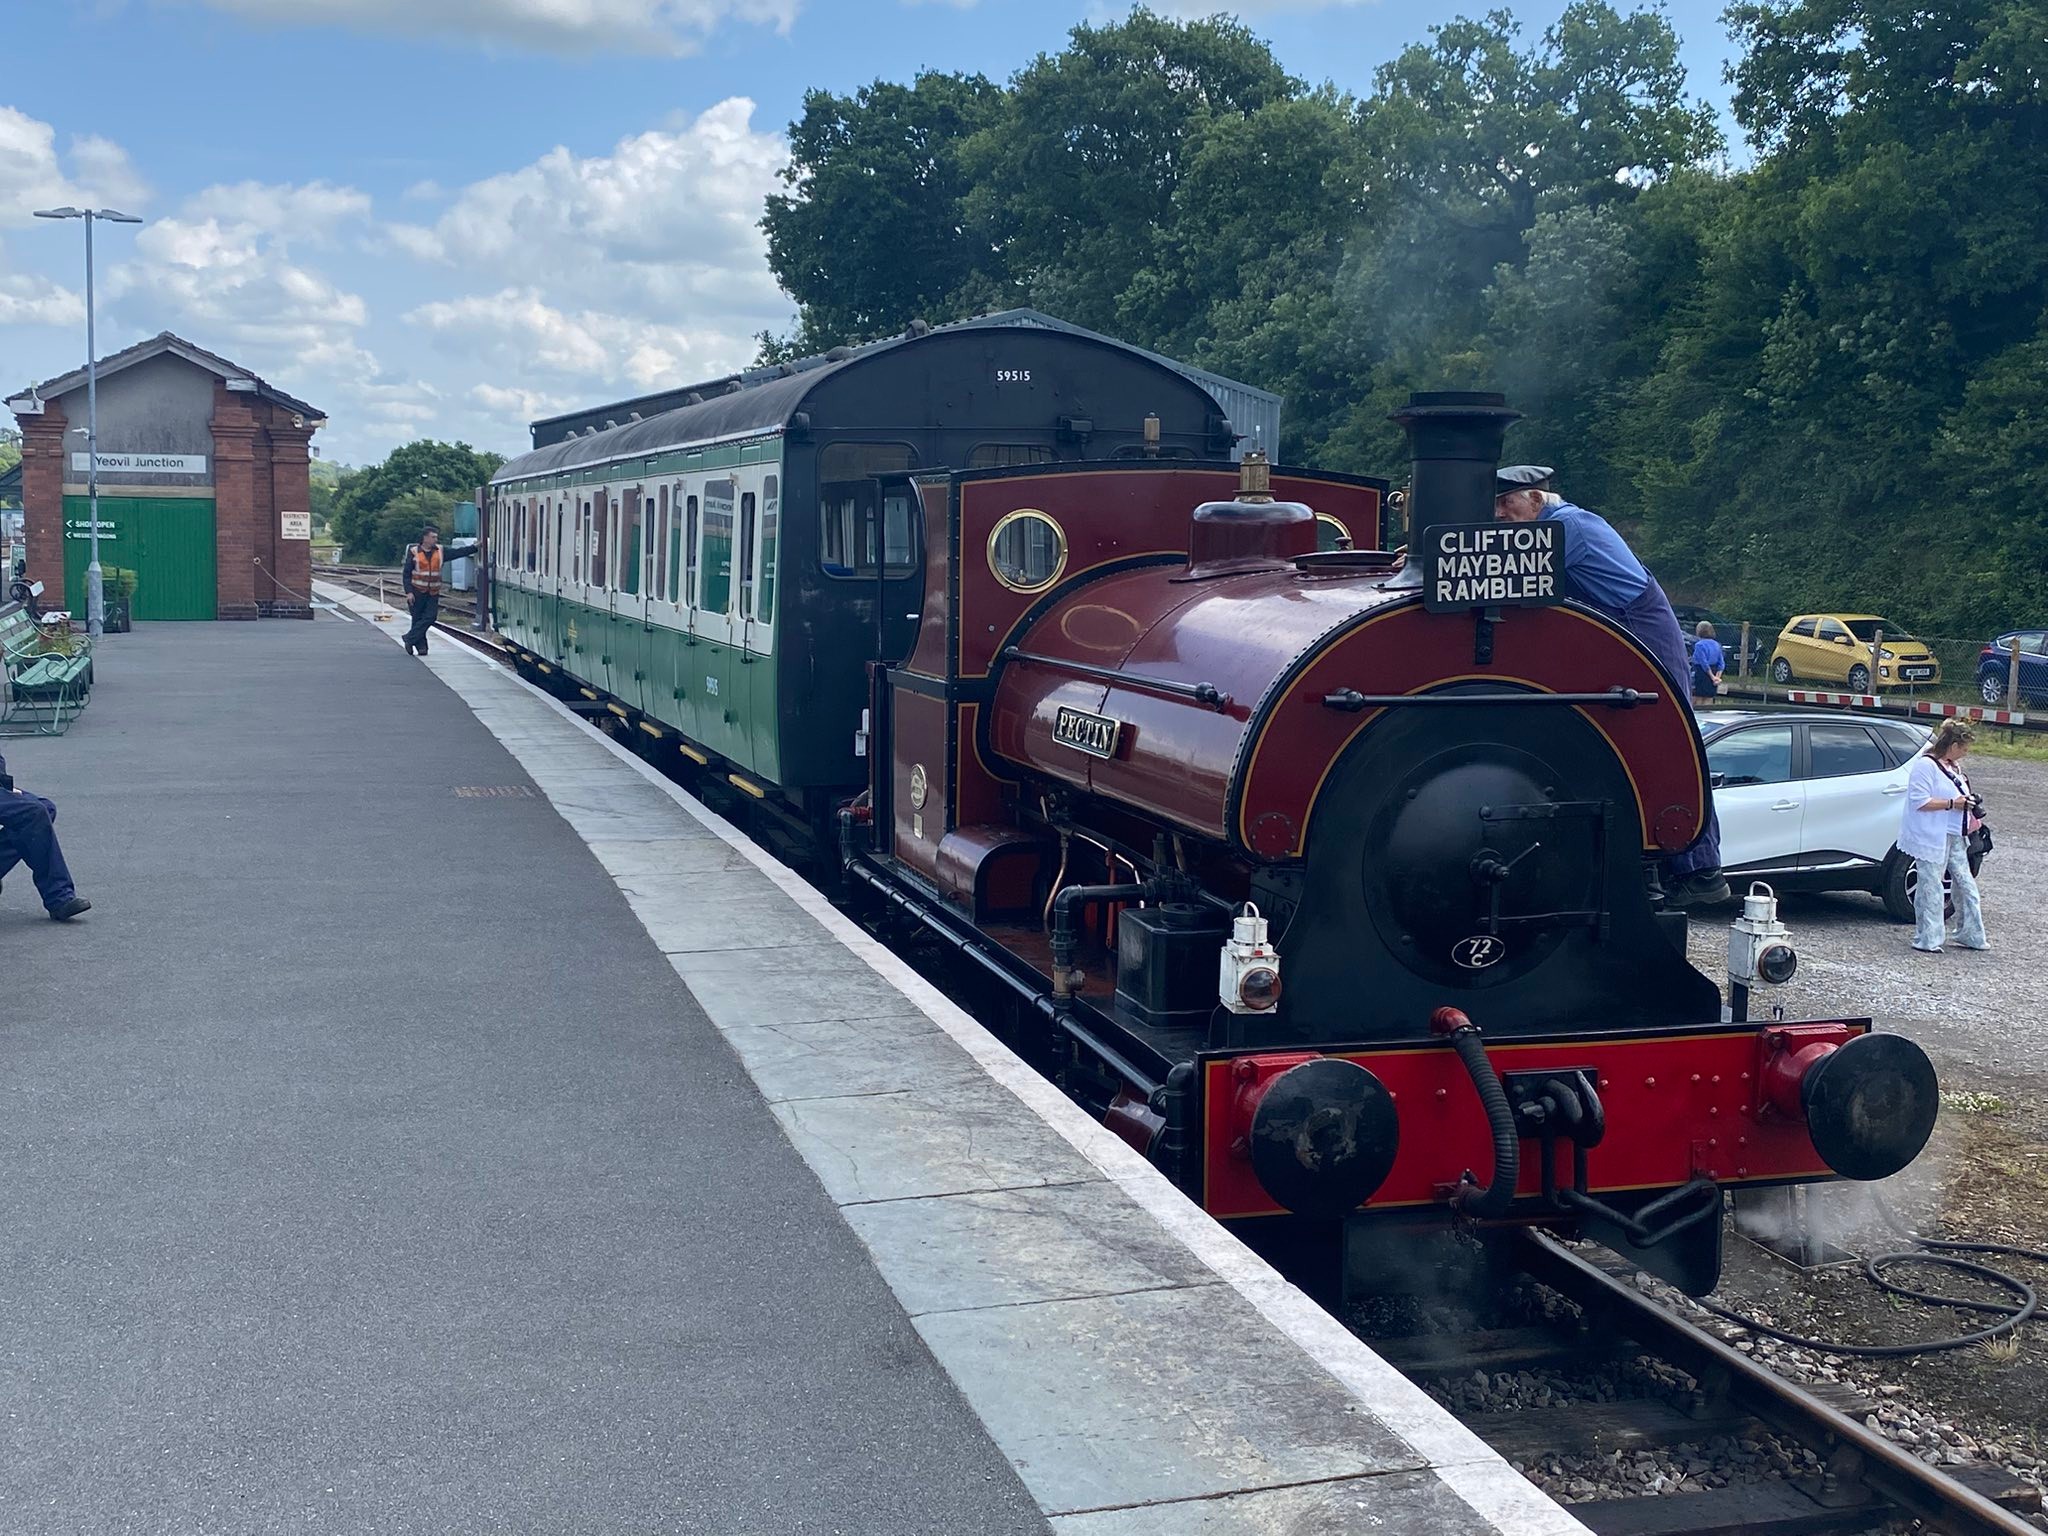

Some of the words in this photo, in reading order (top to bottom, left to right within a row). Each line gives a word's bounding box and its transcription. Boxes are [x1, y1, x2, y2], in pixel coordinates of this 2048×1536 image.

[996, 370, 1031, 381] 59515
[95, 456, 130, 467] Yeovil
[135, 457, 184, 468] Junction
[96, 521, 115, 529] OPEN
[1440, 527, 1552, 553] CLIFTON
[1438, 551, 1554, 578] MAYBANK
[1437, 575, 1554, 602] RAMBLER
[1057, 712, 1112, 751] PECTIN
[1469, 939, 1492, 954] 72
[1471, 953, 1483, 966] C
